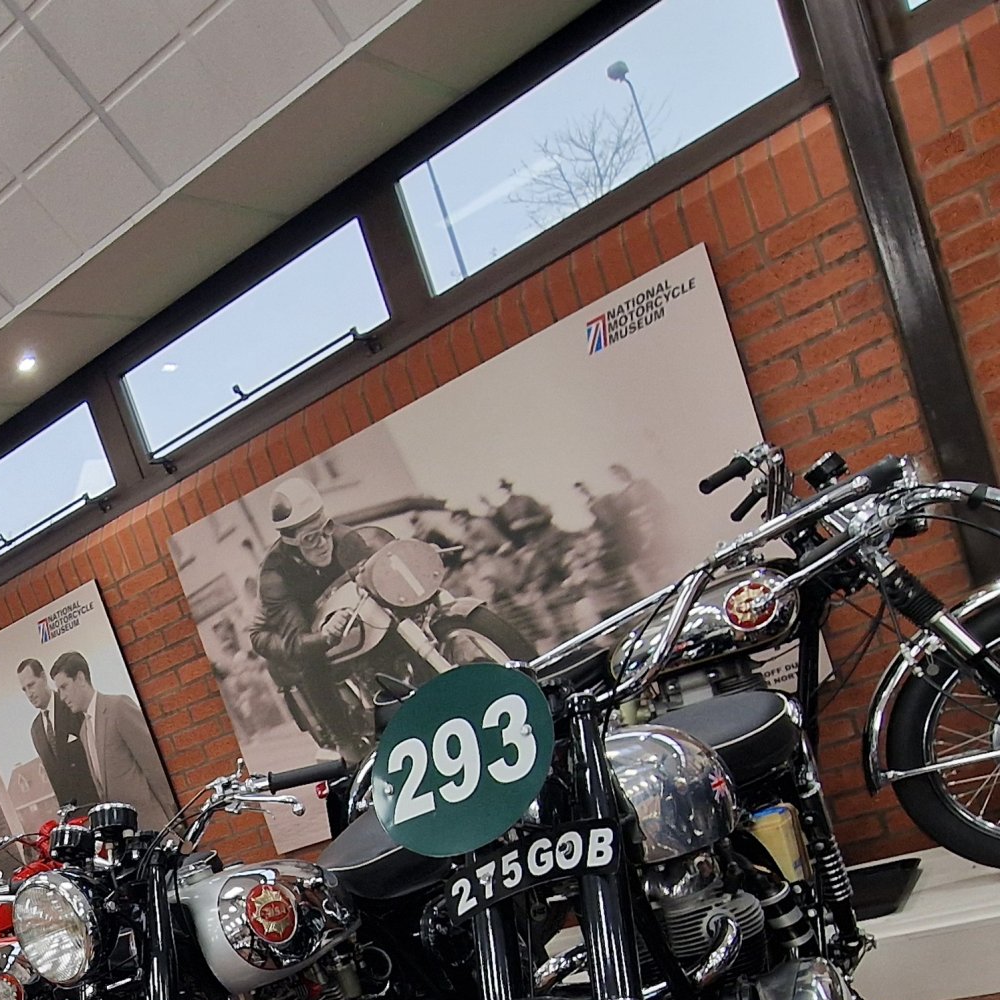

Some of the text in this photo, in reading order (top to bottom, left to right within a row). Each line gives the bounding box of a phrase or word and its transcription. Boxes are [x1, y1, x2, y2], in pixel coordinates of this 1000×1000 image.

[606, 279, 673, 321] NATIONAL
[607, 277, 696, 333] MOTORCYCLE
[608, 306, 665, 345] MUSEUM
[47, 601, 81, 623] NATIONAL
[48, 601, 94, 630] MOTORCYCLE
[50, 619, 80, 639] MUSEUM
[763, 662, 798, 678] OFF DU
[774, 672, 796, 685] NOR
[388, 694, 537, 825] 293
